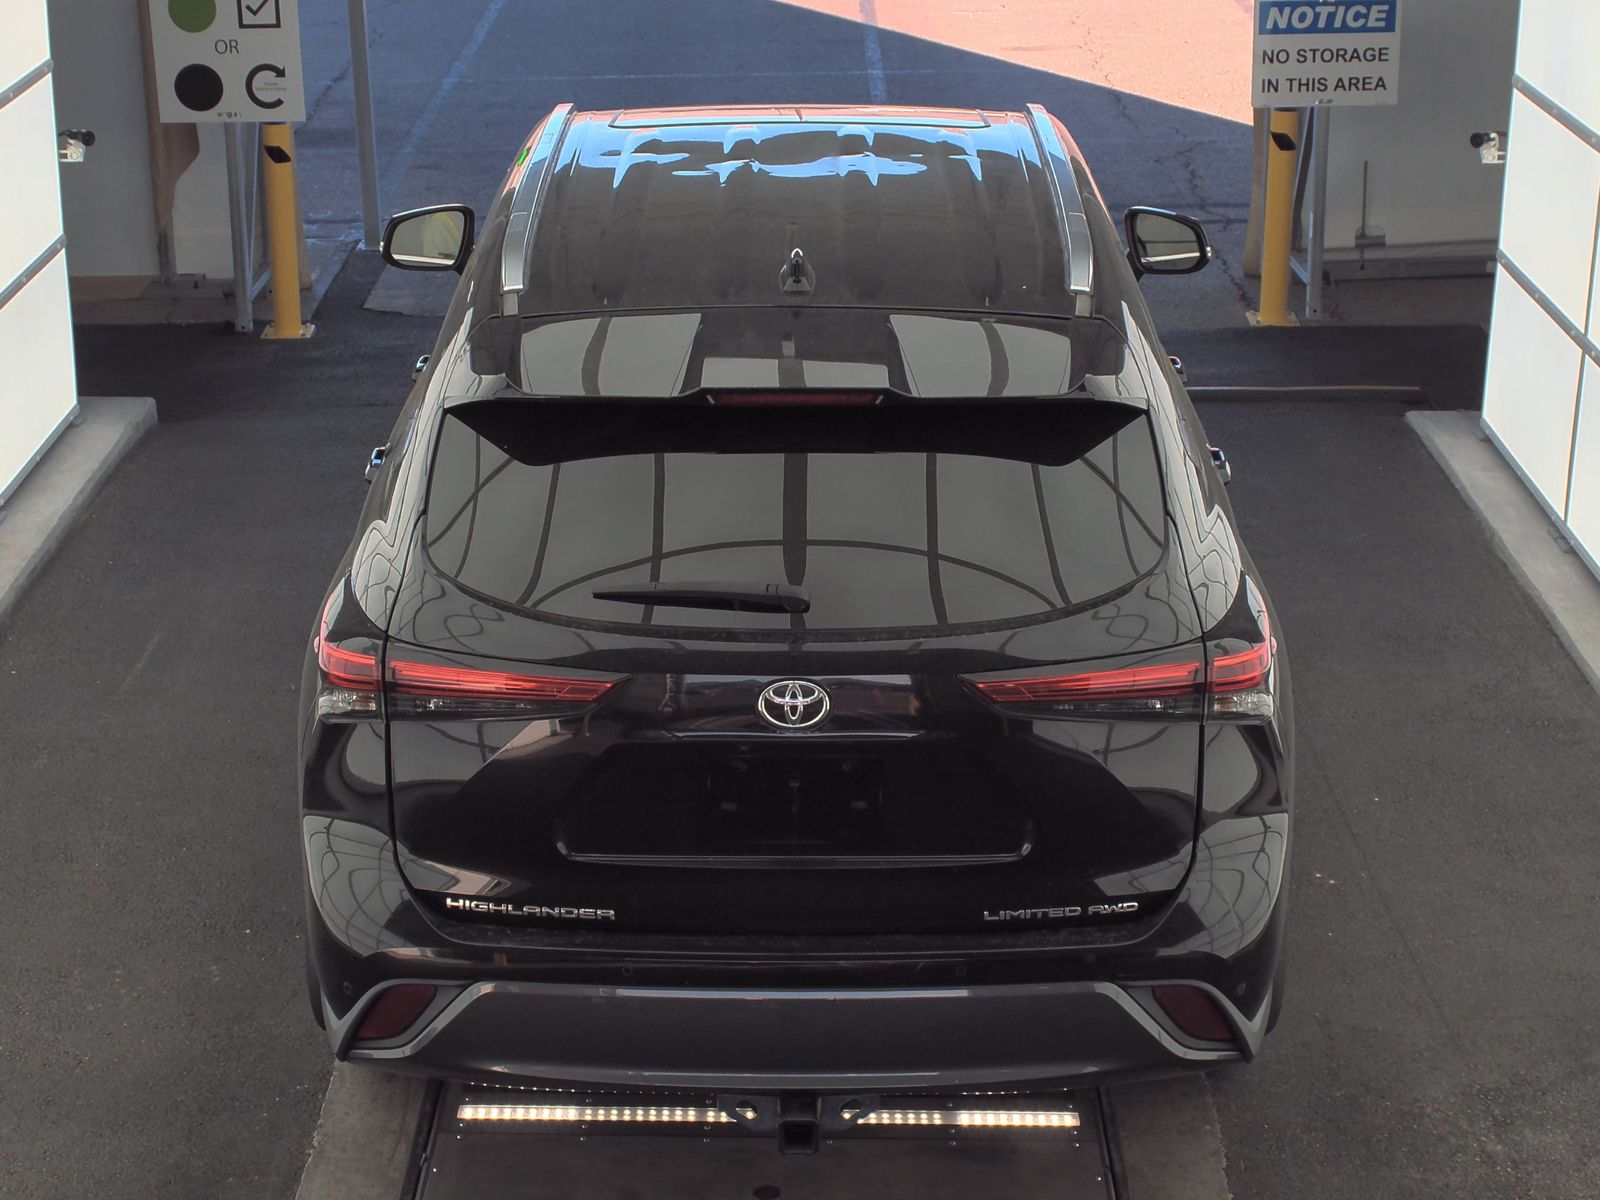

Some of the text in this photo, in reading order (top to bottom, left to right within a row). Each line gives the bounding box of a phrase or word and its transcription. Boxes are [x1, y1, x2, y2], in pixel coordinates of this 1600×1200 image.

[1265, 4, 1390, 29] NOTICE
[214, 38, 240, 54] OR
[1262, 47, 1390, 64] NO STORAGE
[1261, 76, 1388, 93] IN THIS AREA
[446, 897, 616, 920] HIGHLANDER
[983, 901, 1139, 921] LIMITED AWD
